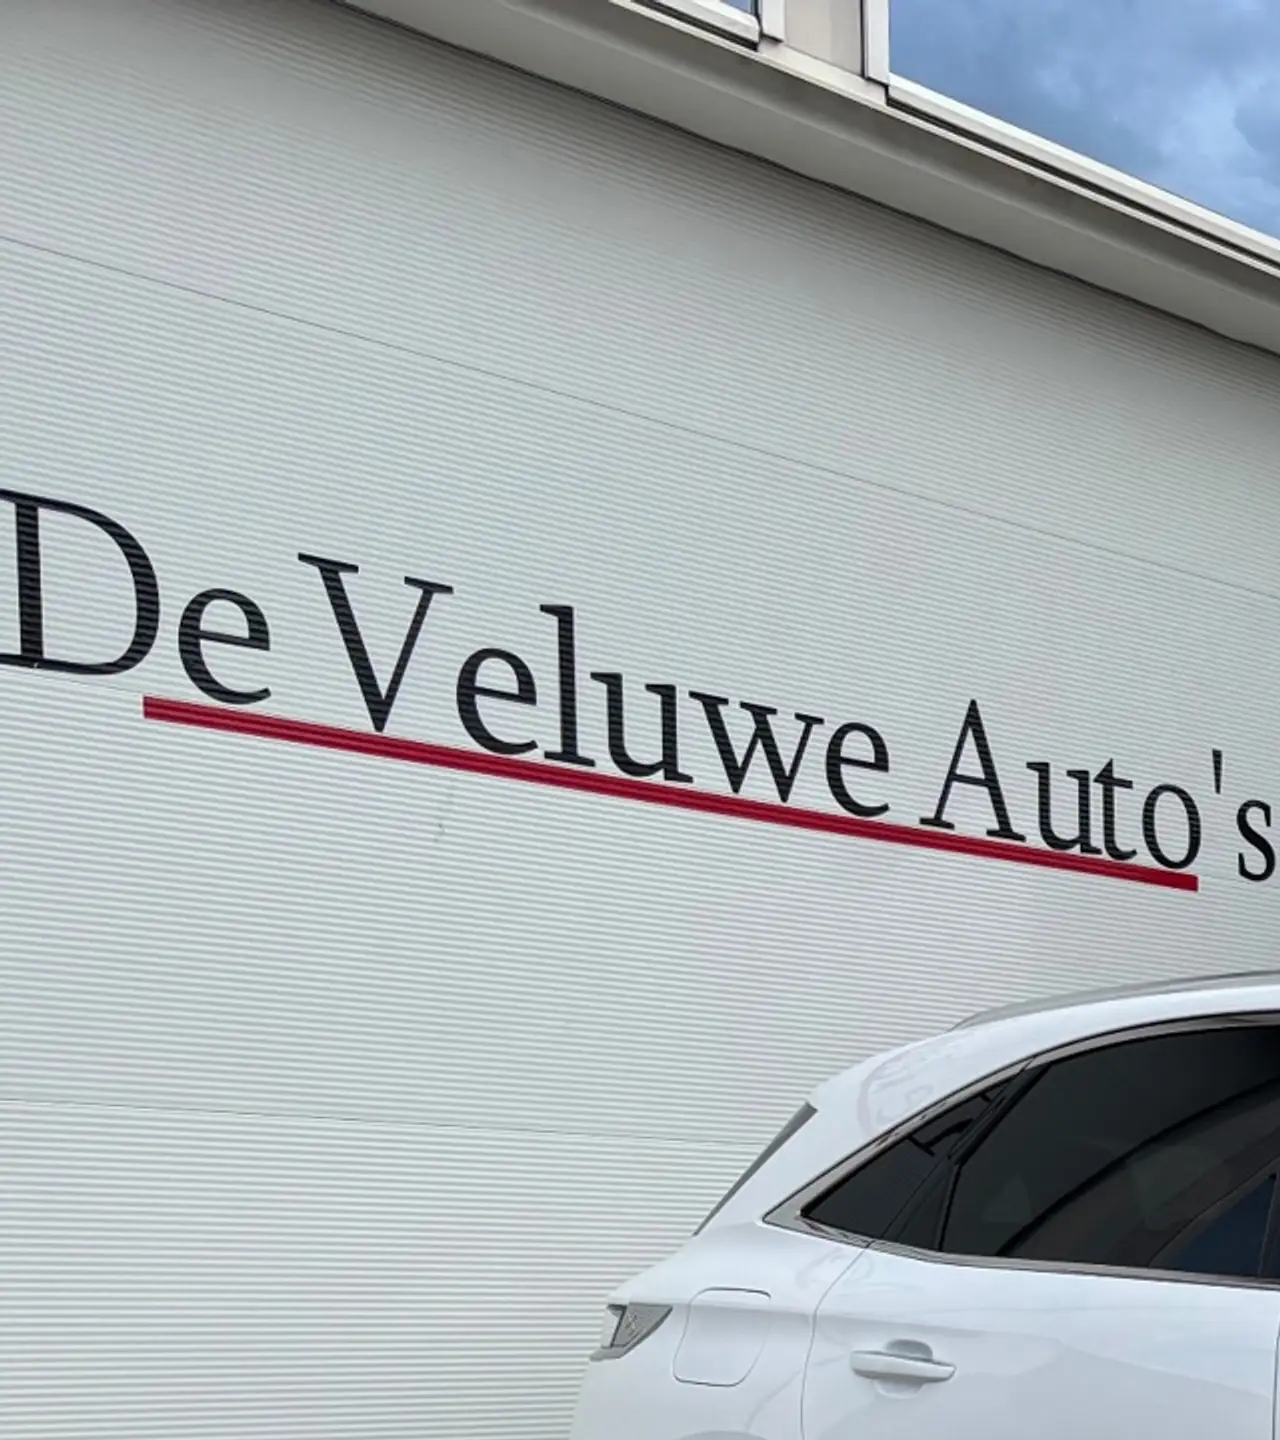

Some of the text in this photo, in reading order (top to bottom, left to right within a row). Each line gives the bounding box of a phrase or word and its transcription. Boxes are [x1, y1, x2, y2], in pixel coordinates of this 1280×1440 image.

[0, 489, 1279, 883] De Veluwe Auto's
